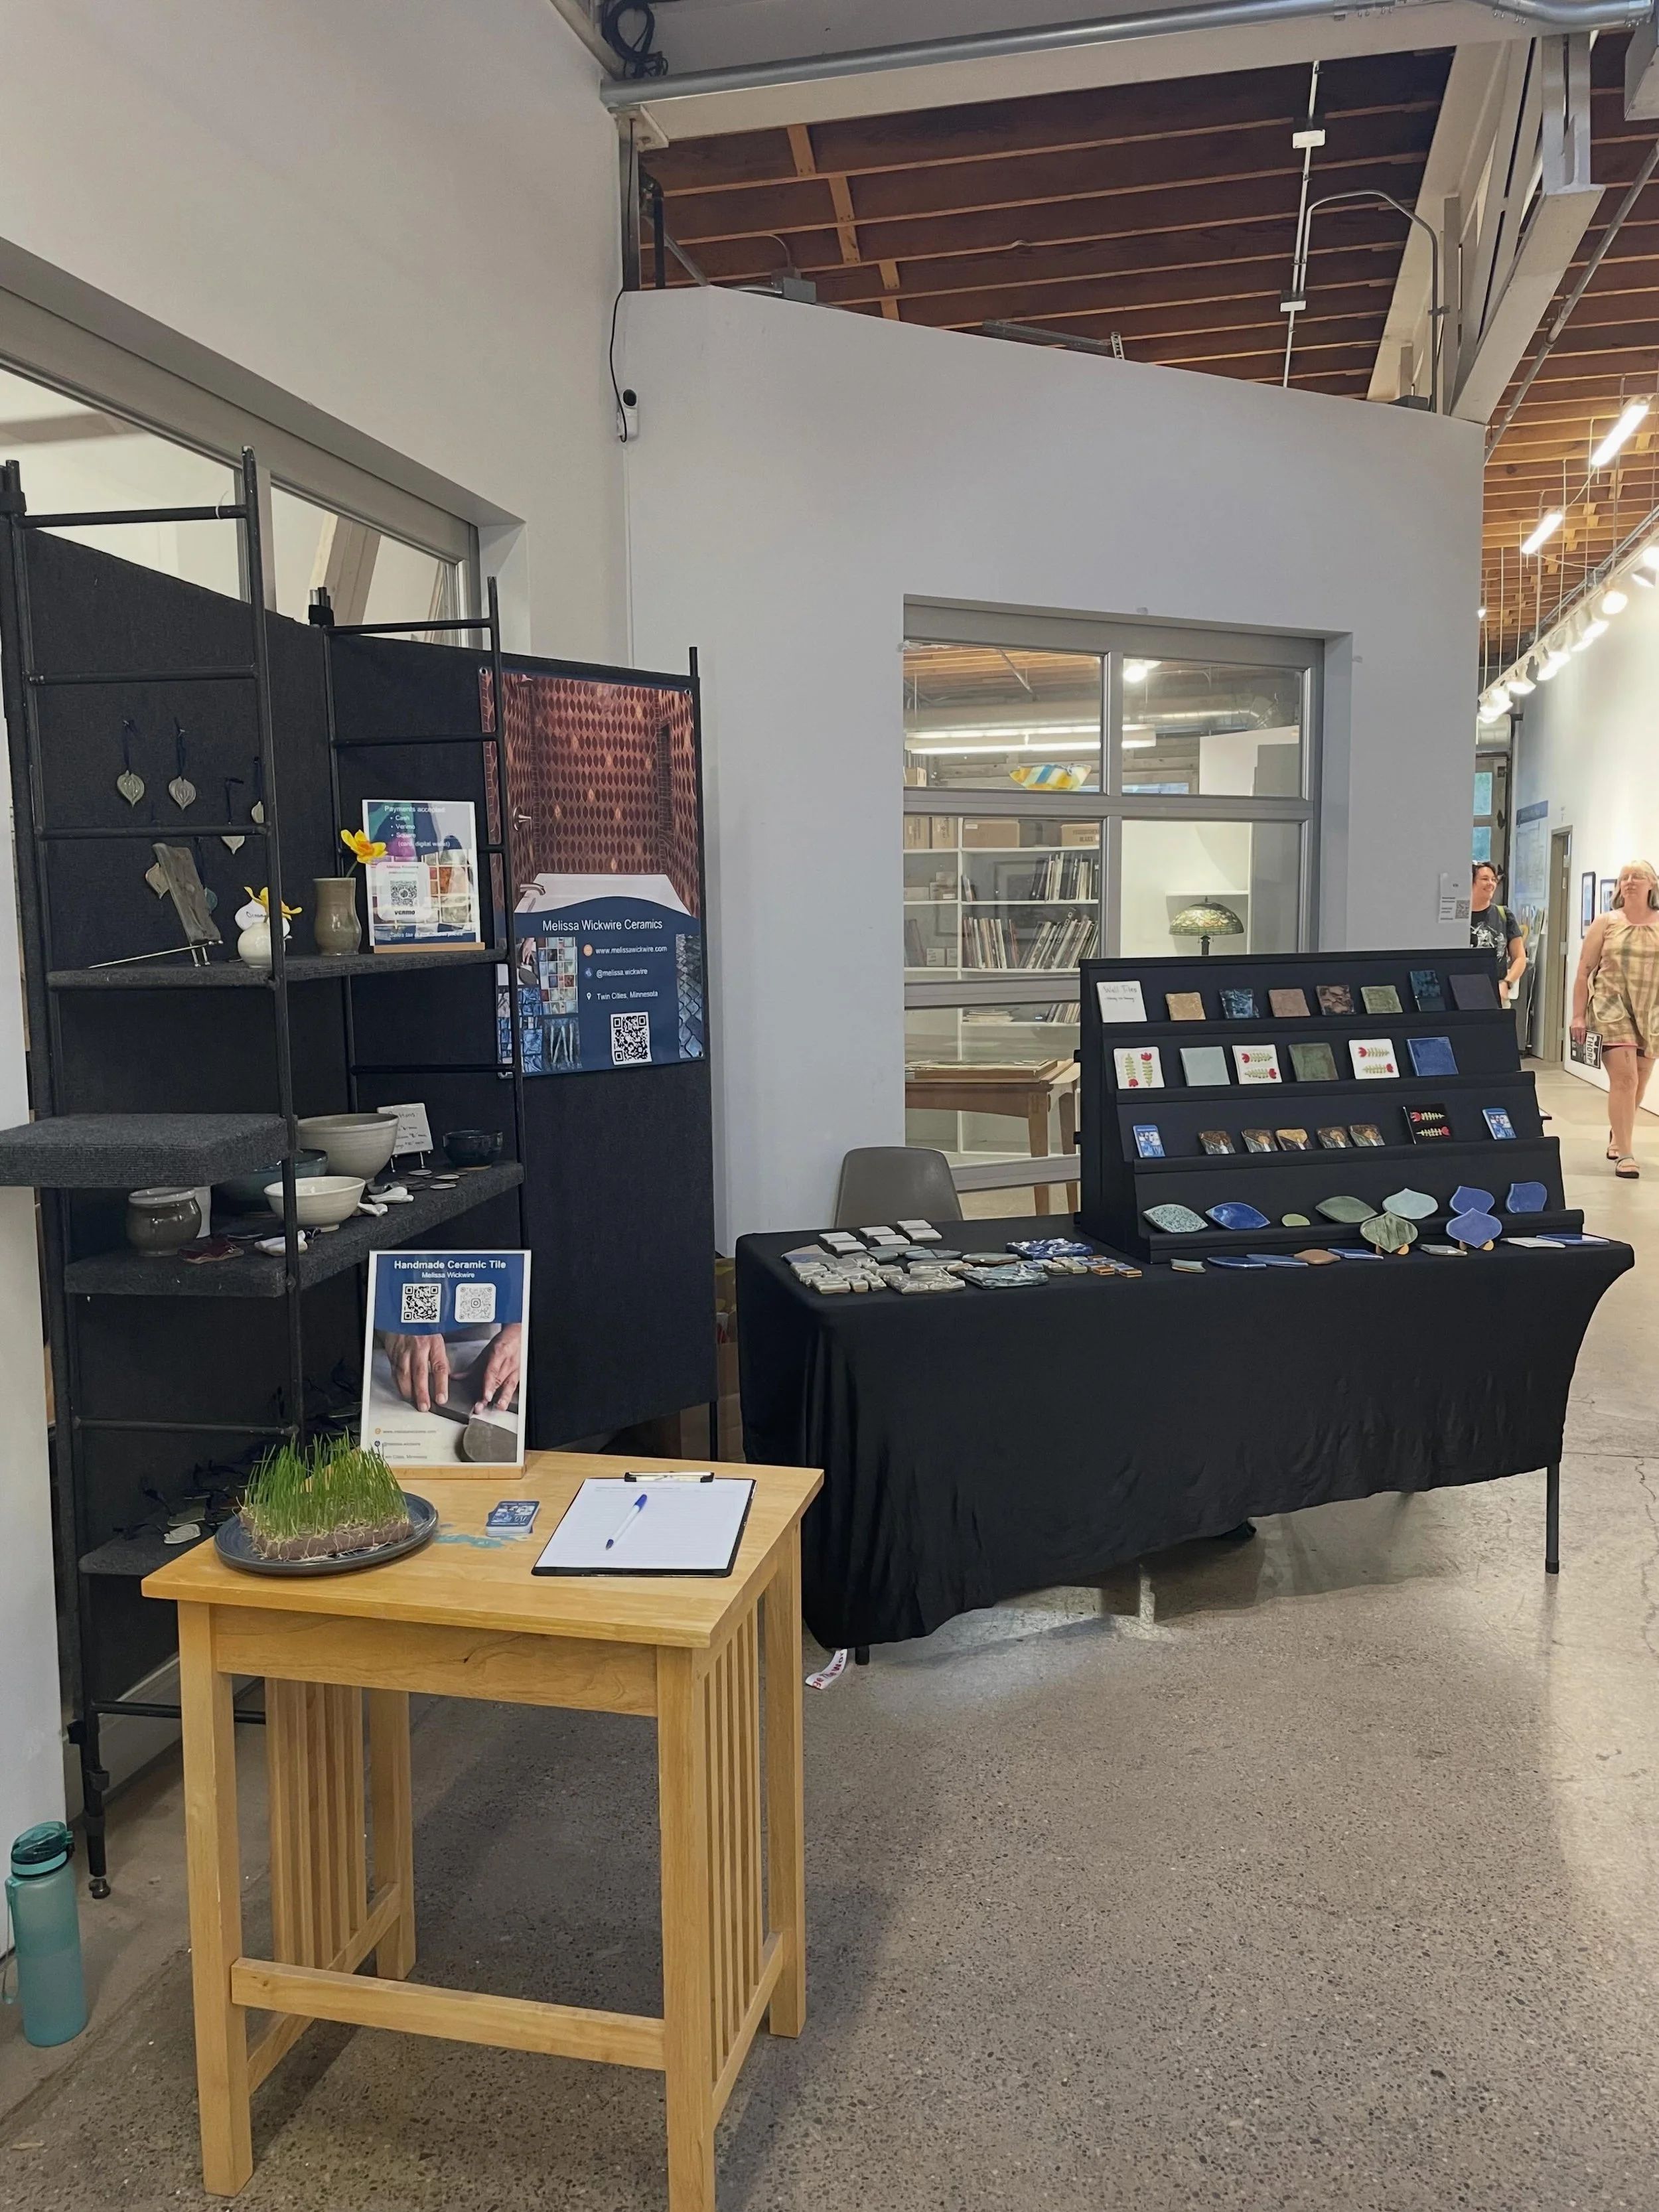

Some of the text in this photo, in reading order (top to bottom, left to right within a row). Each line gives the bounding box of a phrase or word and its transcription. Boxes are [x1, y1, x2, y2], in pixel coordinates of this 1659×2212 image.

[542, 919, 663, 931] Melissa Wickwire Ceramics
[595, 945, 668, 954] www.melissawickwire.com
[596, 966, 648, 979] @melissa.wickwire
[394, 1260, 507, 1270] Handmade Ceramic Tile
